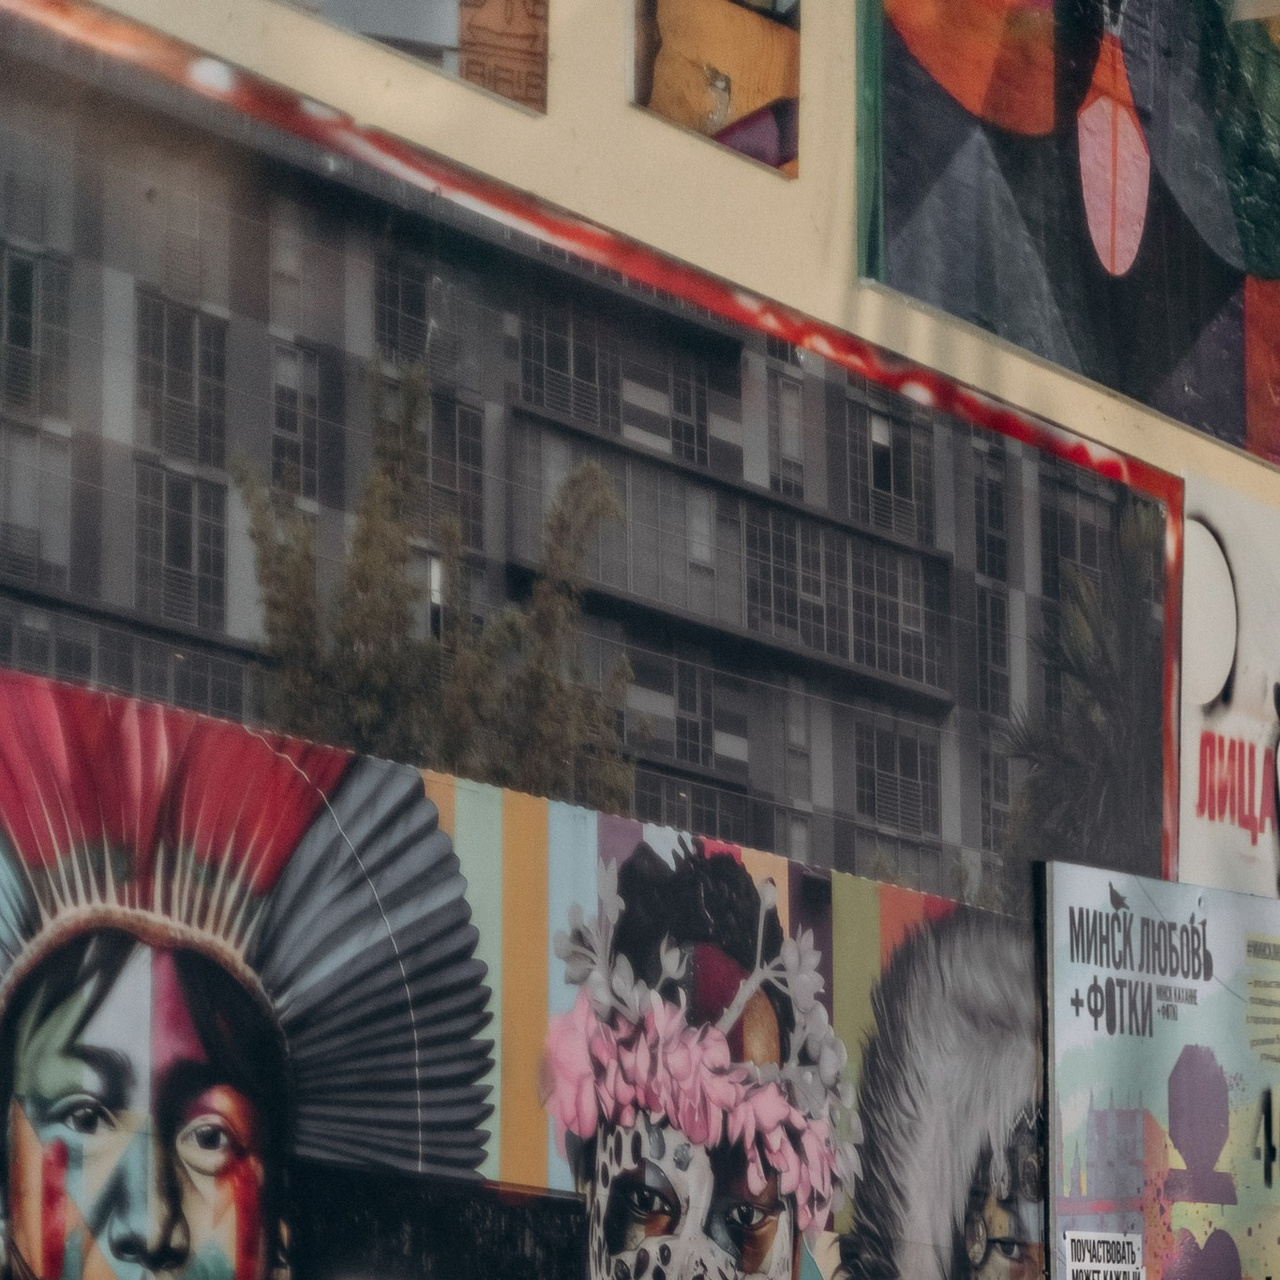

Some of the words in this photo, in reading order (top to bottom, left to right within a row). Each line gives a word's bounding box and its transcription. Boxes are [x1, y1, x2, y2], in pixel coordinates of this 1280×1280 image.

[1069, 906, 1134, 970] МИНСК
[1138, 914, 1213, 981] ЛЮБОВЬ
[1087, 975, 1153, 1037] ФОТКИ
[1071, 1238, 1136, 1265] ПОУЧАСТВОВАТЬ
